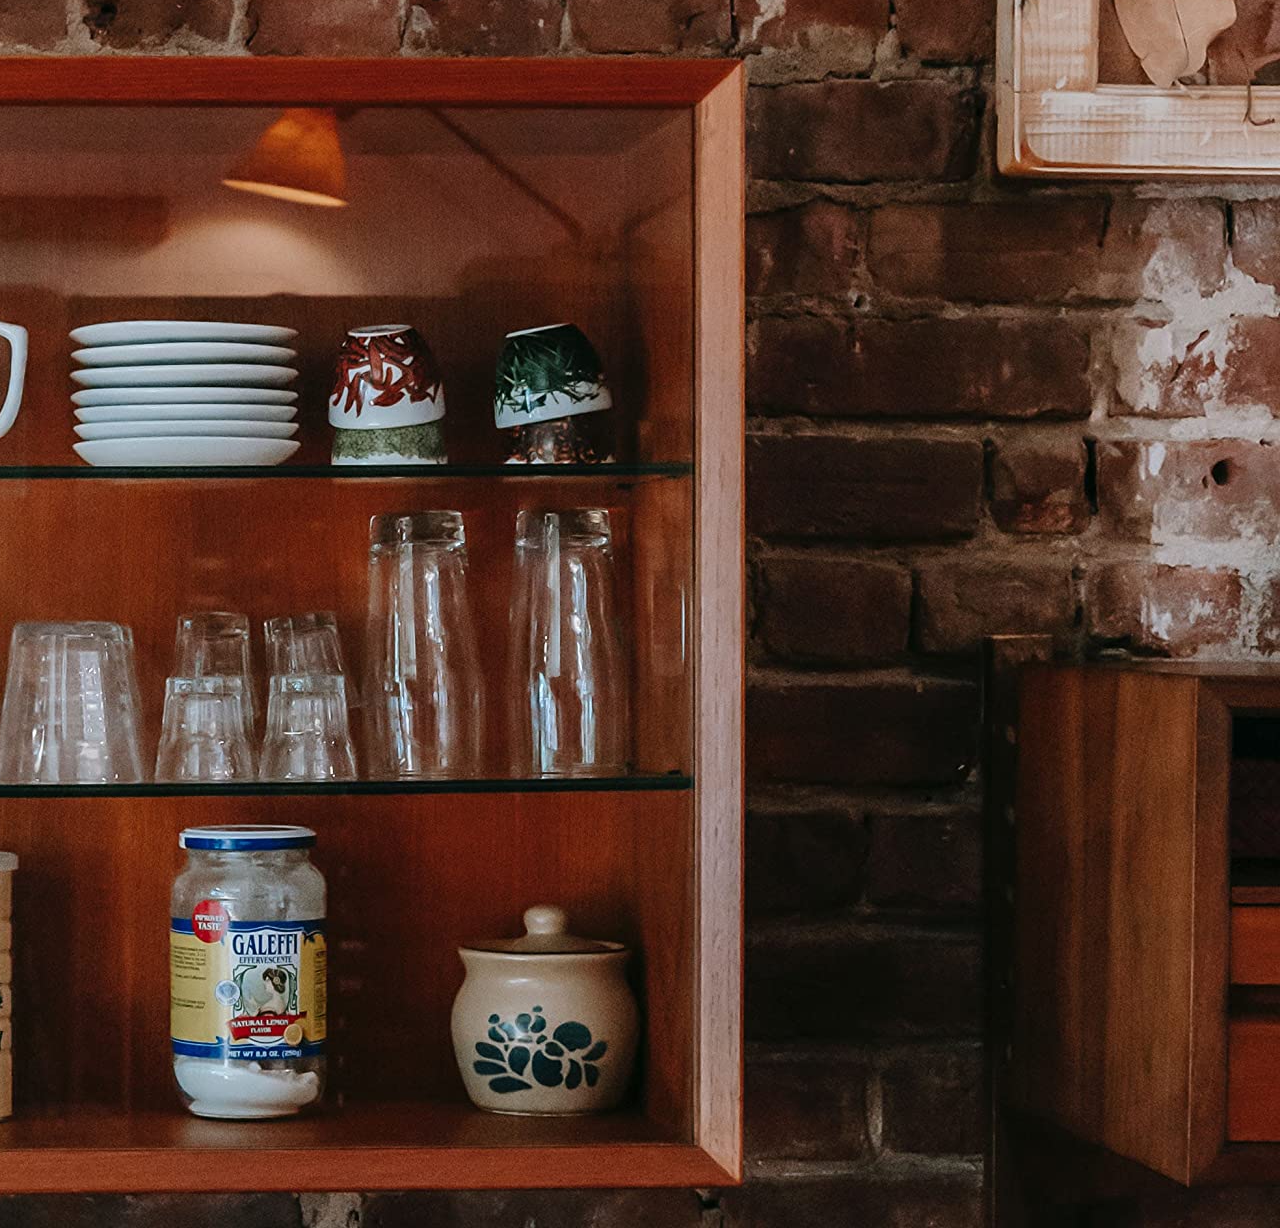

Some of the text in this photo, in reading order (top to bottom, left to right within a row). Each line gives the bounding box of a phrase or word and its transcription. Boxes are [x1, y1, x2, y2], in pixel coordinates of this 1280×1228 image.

[197, 922, 222, 931] TASTE
[232, 933, 298, 956] GALEFFI
[232, 1019, 265, 1028] NATURAL
